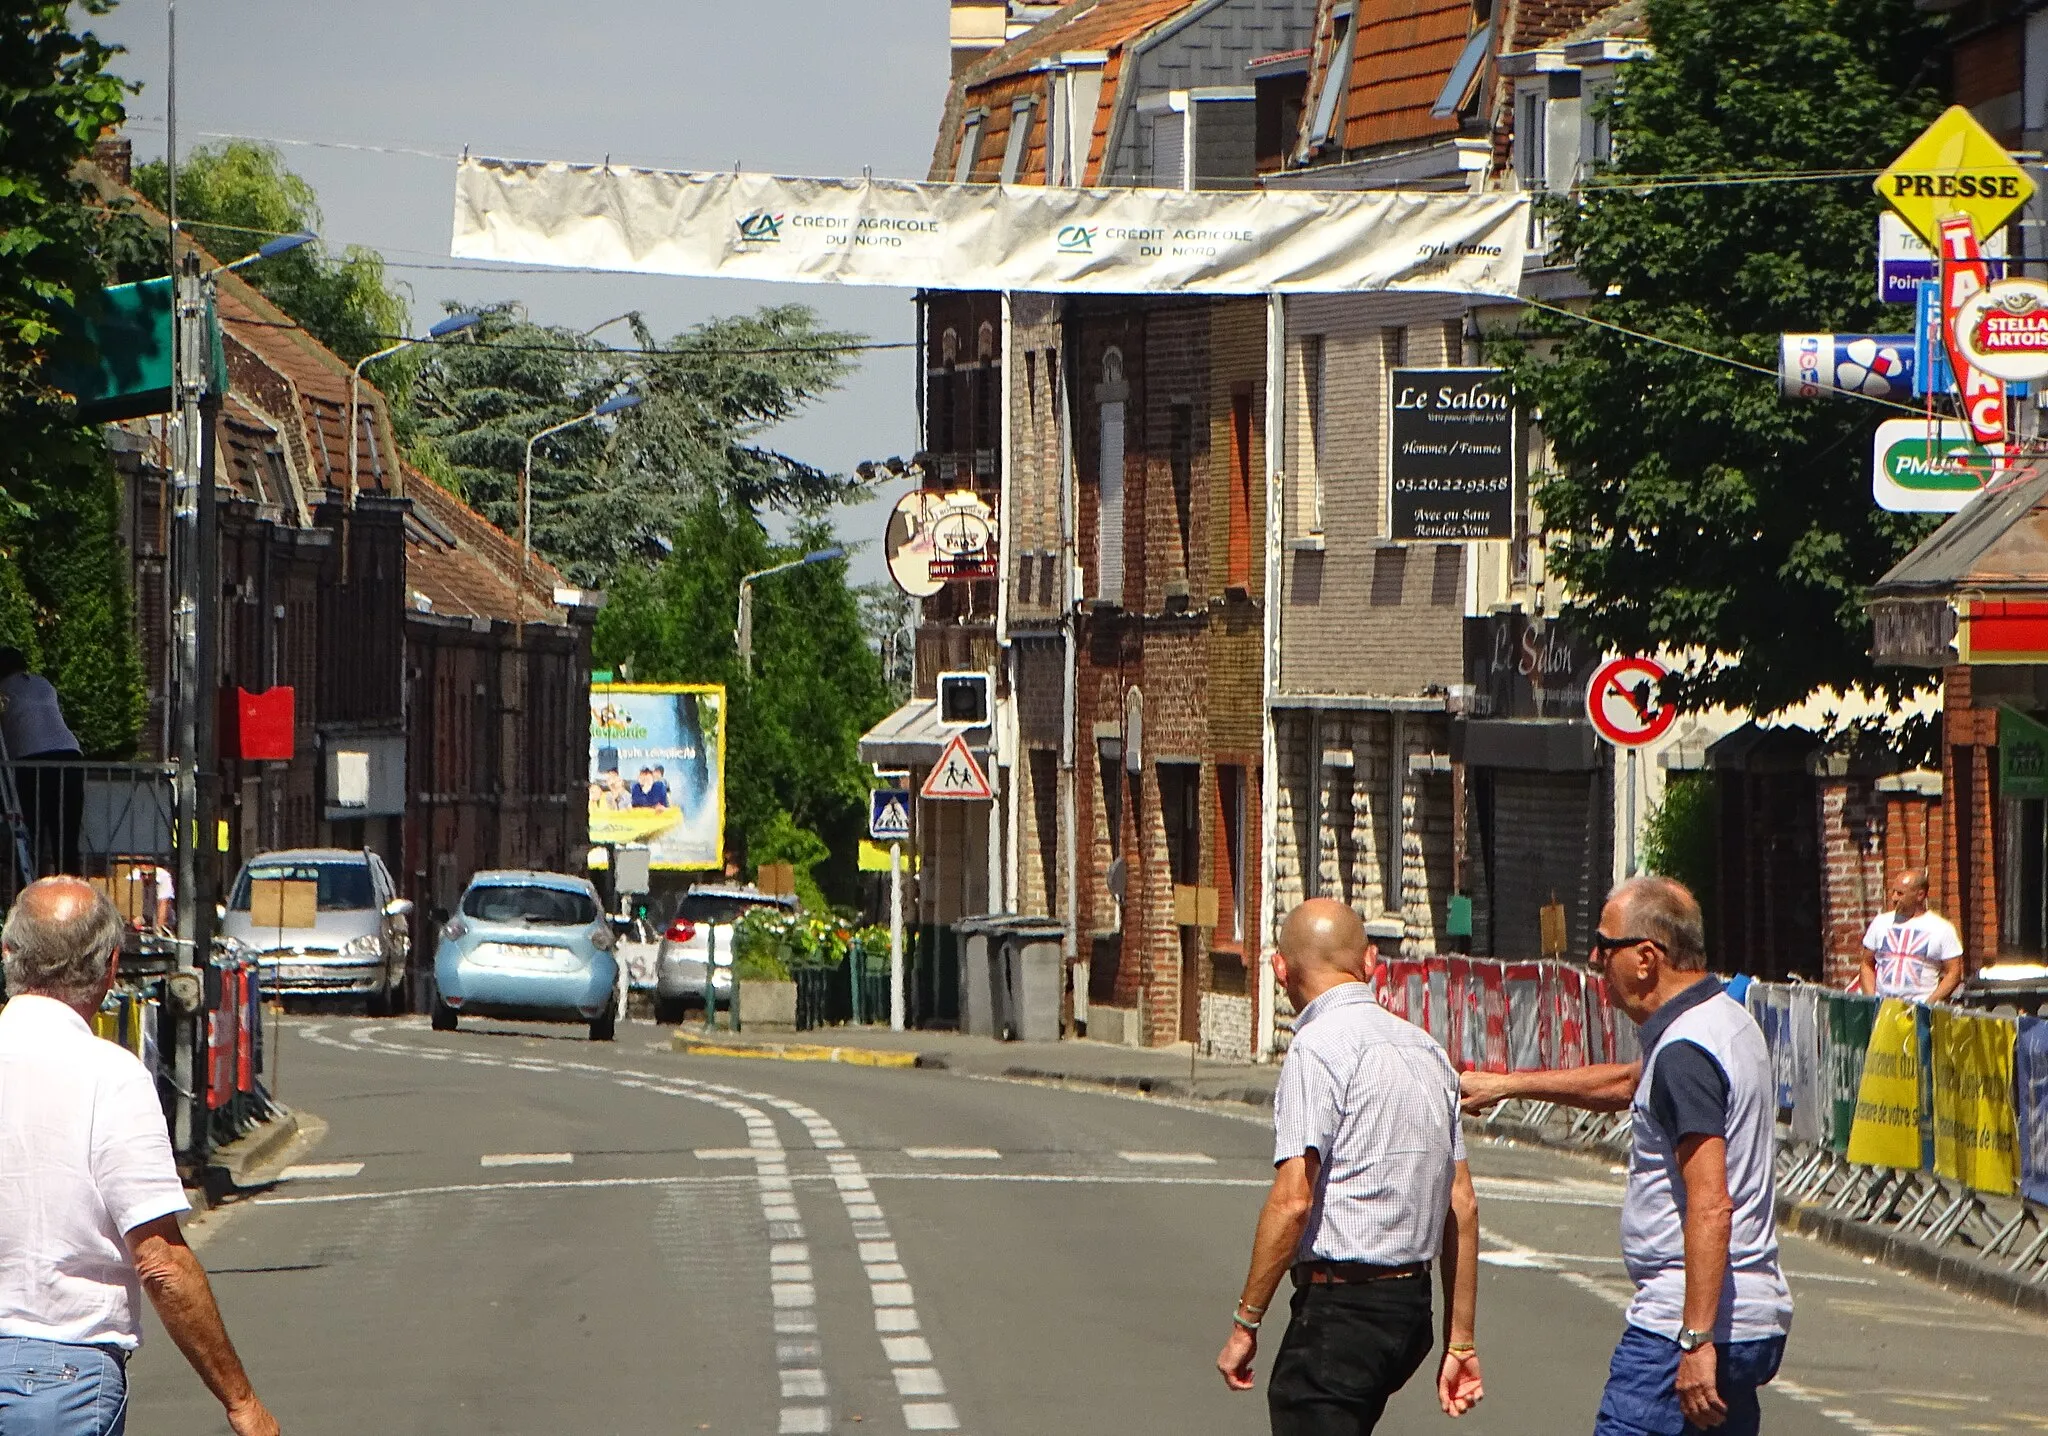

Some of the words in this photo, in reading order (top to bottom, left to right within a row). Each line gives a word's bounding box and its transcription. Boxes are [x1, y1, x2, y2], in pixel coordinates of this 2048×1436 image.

[1893, 174, 2020, 198] PRESSE
[792, 214, 849, 229] CRÉDIT
[857, 217, 939, 233] AGRICOLE
[826, 234, 846, 246] DU
[855, 235, 902, 248] NORD
[1105, 225, 1165, 241] CRÉDIT
[1173, 228, 1253, 243] AGRICOLE
[1140, 246, 1163, 257] DU
[1172, 246, 1216, 257] NORD
[1944, 227, 2002, 435] TAAC
[1987, 317, 2048, 332] STELLA
[1987, 332, 2048, 347] ARTOIS
[1395, 386, 1428, 410] Le
[1436, 382, 1508, 410] Salon
[1402, 440, 1448, 455] Hommes
[1459, 440, 1502, 455] Femmes
[1395, 476, 1508, 494] 03.20.22.93.58
[1414, 508, 1441, 522] Avec
[1443, 510, 1459, 521] ou
[1462, 508, 1491, 522] Sans
[1414, 523, 1490, 537] Rendez-Vous
[1518, 623, 1572, 676] Salon
